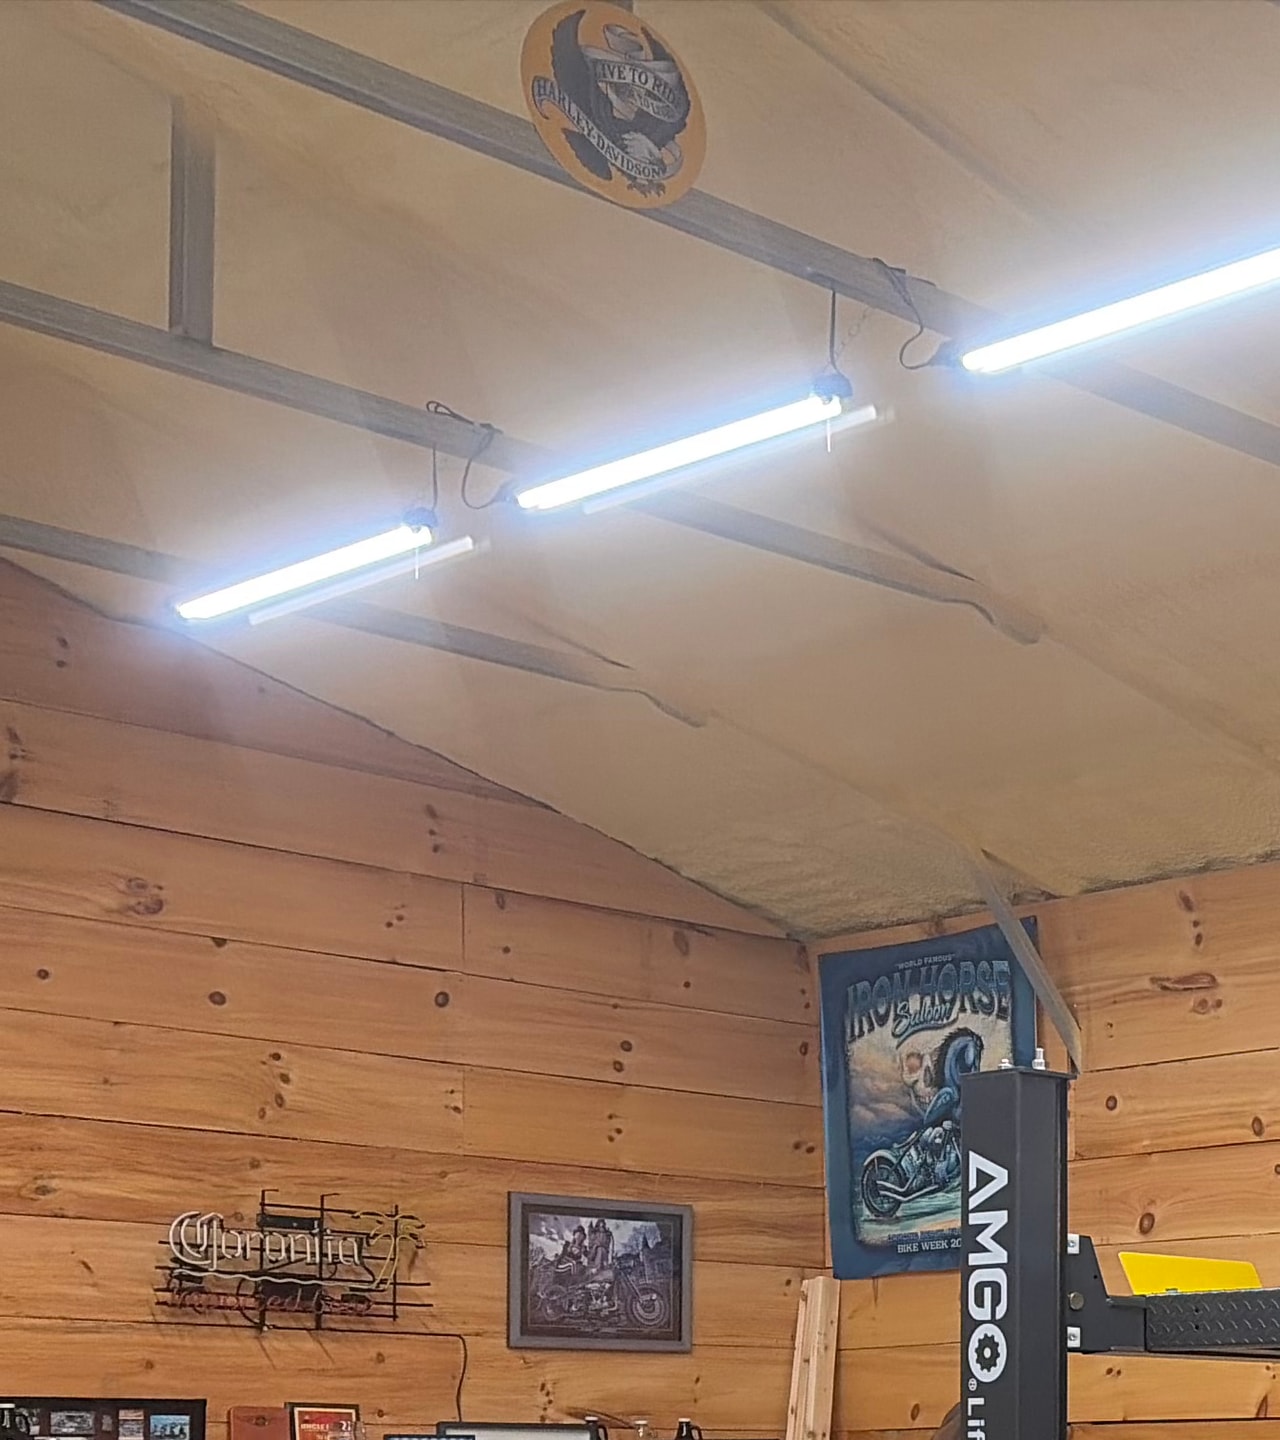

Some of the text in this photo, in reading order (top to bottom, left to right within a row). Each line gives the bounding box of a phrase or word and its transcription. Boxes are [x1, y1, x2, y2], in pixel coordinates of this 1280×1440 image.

[629, 67, 649, 86] TO
[846, 960, 1012, 1044] IRON HORSE
[892, 1000, 953, 1038] Saloon
[168, 1211, 361, 1271] Coronita
[897, 1242, 919, 1254] BIKE
[921, 1239, 949, 1251] WEEK
[967, 1150, 1009, 1383] AMGO
